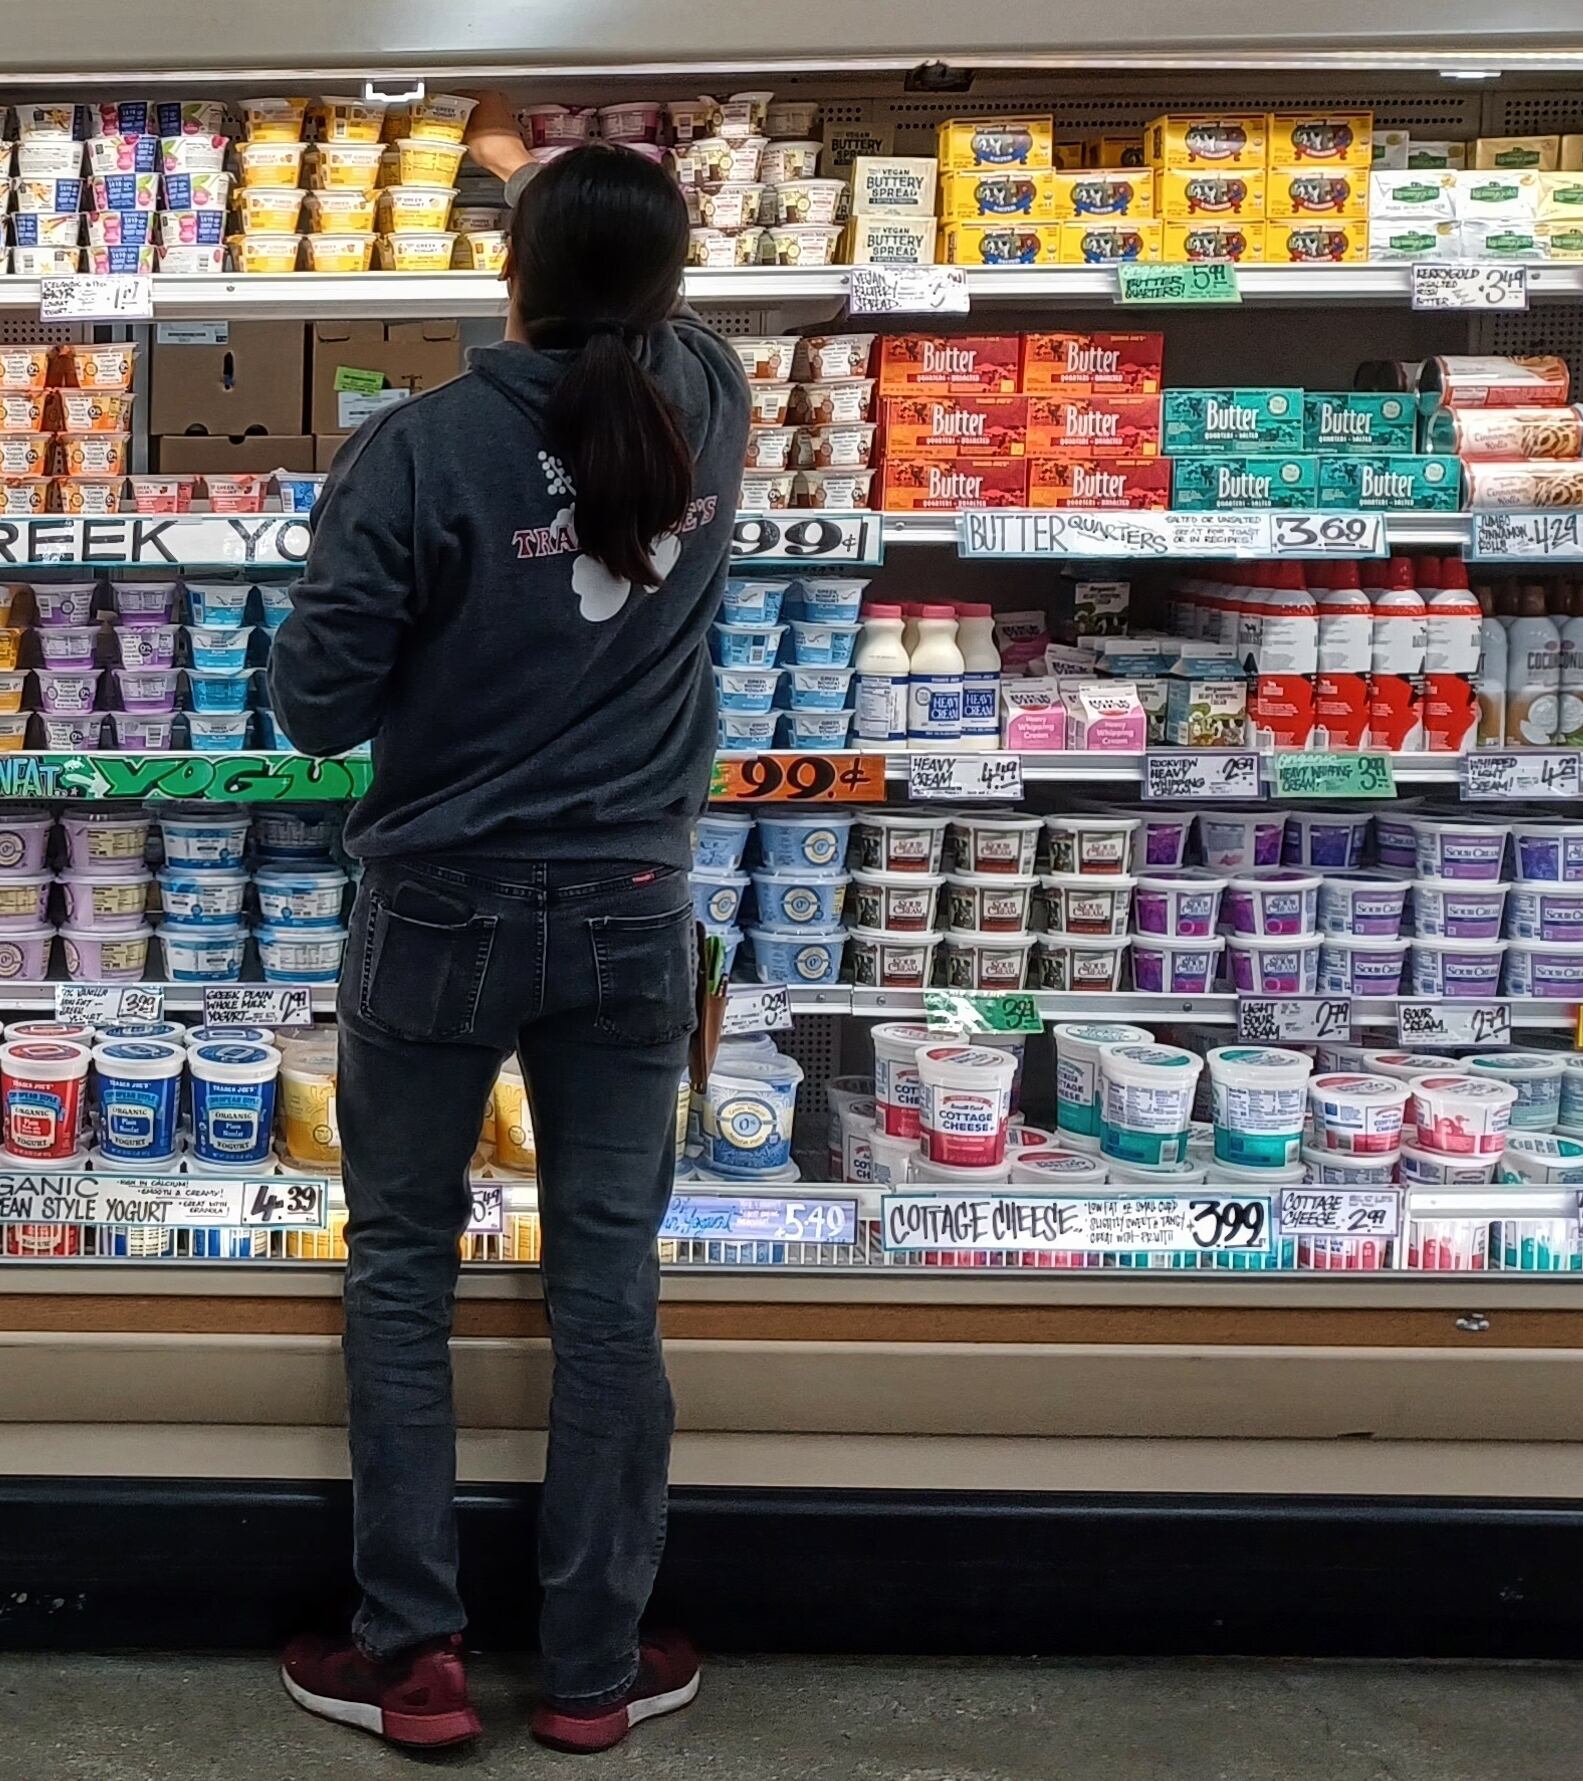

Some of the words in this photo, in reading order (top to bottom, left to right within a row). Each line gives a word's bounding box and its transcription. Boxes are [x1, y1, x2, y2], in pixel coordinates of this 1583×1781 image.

[866, 176, 925, 190] BUTTERY
[871, 188, 918, 198] SPREAD
[867, 234, 925, 248] BUTTERY
[872, 246, 918, 256] SPREAD
[923, 341, 977, 372] Butter
[1067, 341, 1120, 373] Butter
[931, 404, 987, 437] Butter
[1065, 404, 1120, 437] Butter
[1206, 399, 1260, 431] Butter
[1320, 402, 1373, 435] Butter
[927, 467, 984, 500] Butter
[1072, 467, 1128, 499] Butter
[1218, 467, 1272, 500] Butter
[969, 515, 1068, 551] BUTTER
[912, 757, 957, 772] HEAVY
[939, 1109, 993, 1122] COTTAGE
[942, 1120, 990, 1132] CHEESE
[40, 1198, 97, 1220] STYLE
[106, 1197, 173, 1224] YOGURT
[1282, 1192, 1344, 1212] COTTAGE
[890, 1201, 992, 1245] COTTAGE
